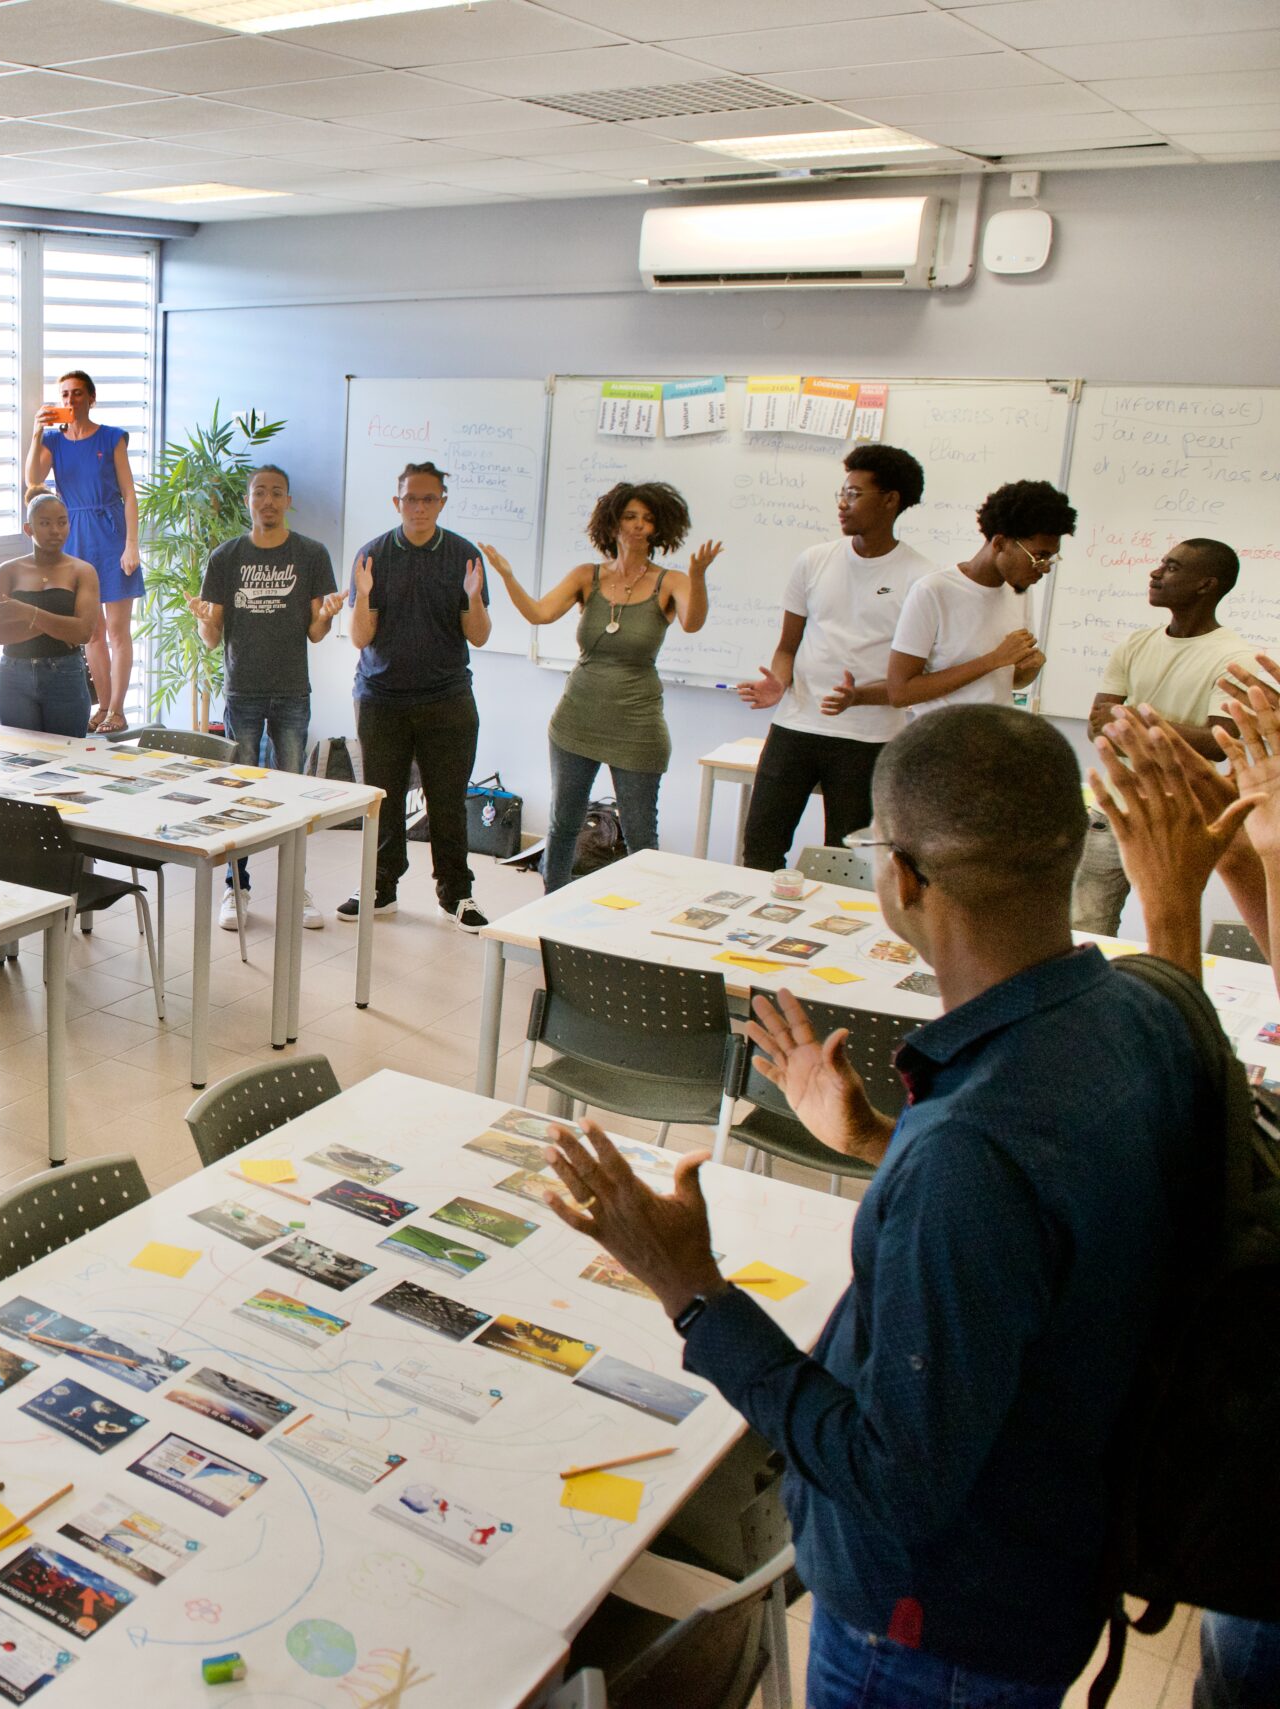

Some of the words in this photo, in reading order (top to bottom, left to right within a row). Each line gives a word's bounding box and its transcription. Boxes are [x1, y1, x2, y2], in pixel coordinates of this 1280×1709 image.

[682, 402, 690, 431] Voiture
[240, 564, 296, 582] Marshall
[218, 1413, 231, 1423] de
[229, 1418, 254, 1434] Fonte
[190, 1490, 213, 1507] Bilan
[33, 1600, 57, 1617] serre
[55, 1613, 70, 1625] de
